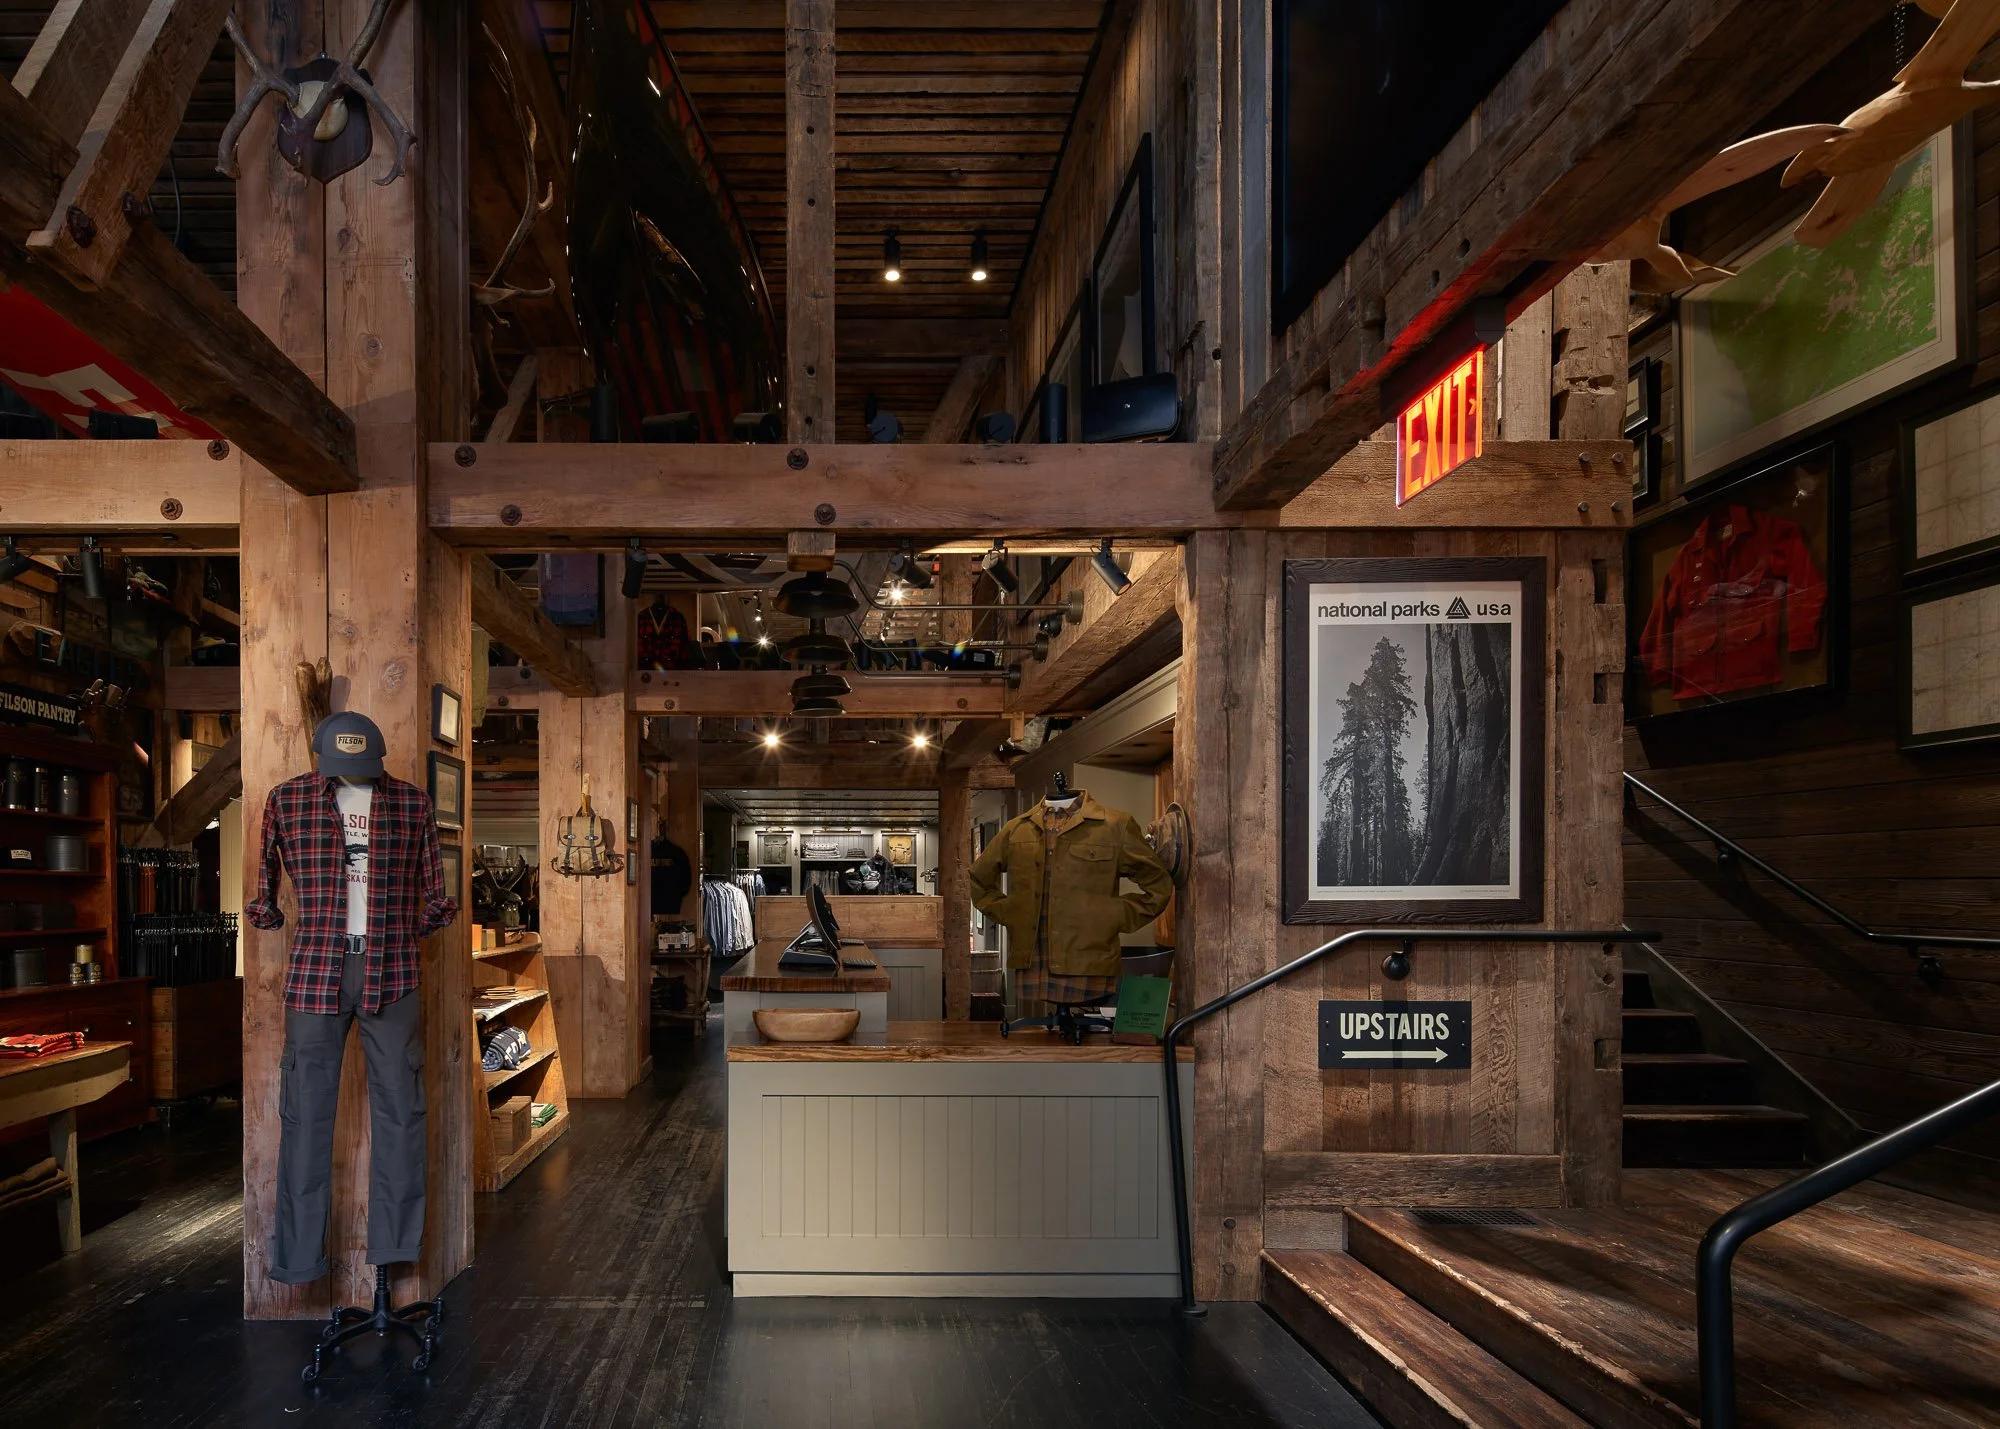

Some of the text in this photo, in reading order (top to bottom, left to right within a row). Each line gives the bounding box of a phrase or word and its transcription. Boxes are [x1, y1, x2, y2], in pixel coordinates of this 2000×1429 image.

[1405, 359, 1472, 499] EXIT
[1318, 601, 1511, 620] national parks usa
[0, 691, 76, 725] FILSON PANTRY
[338, 736, 364, 745] FILSON
[341, 813, 367, 830] LSO
[346, 873, 361, 883] SKA
[1340, 1012, 1450, 1041] UPSTAIRS
